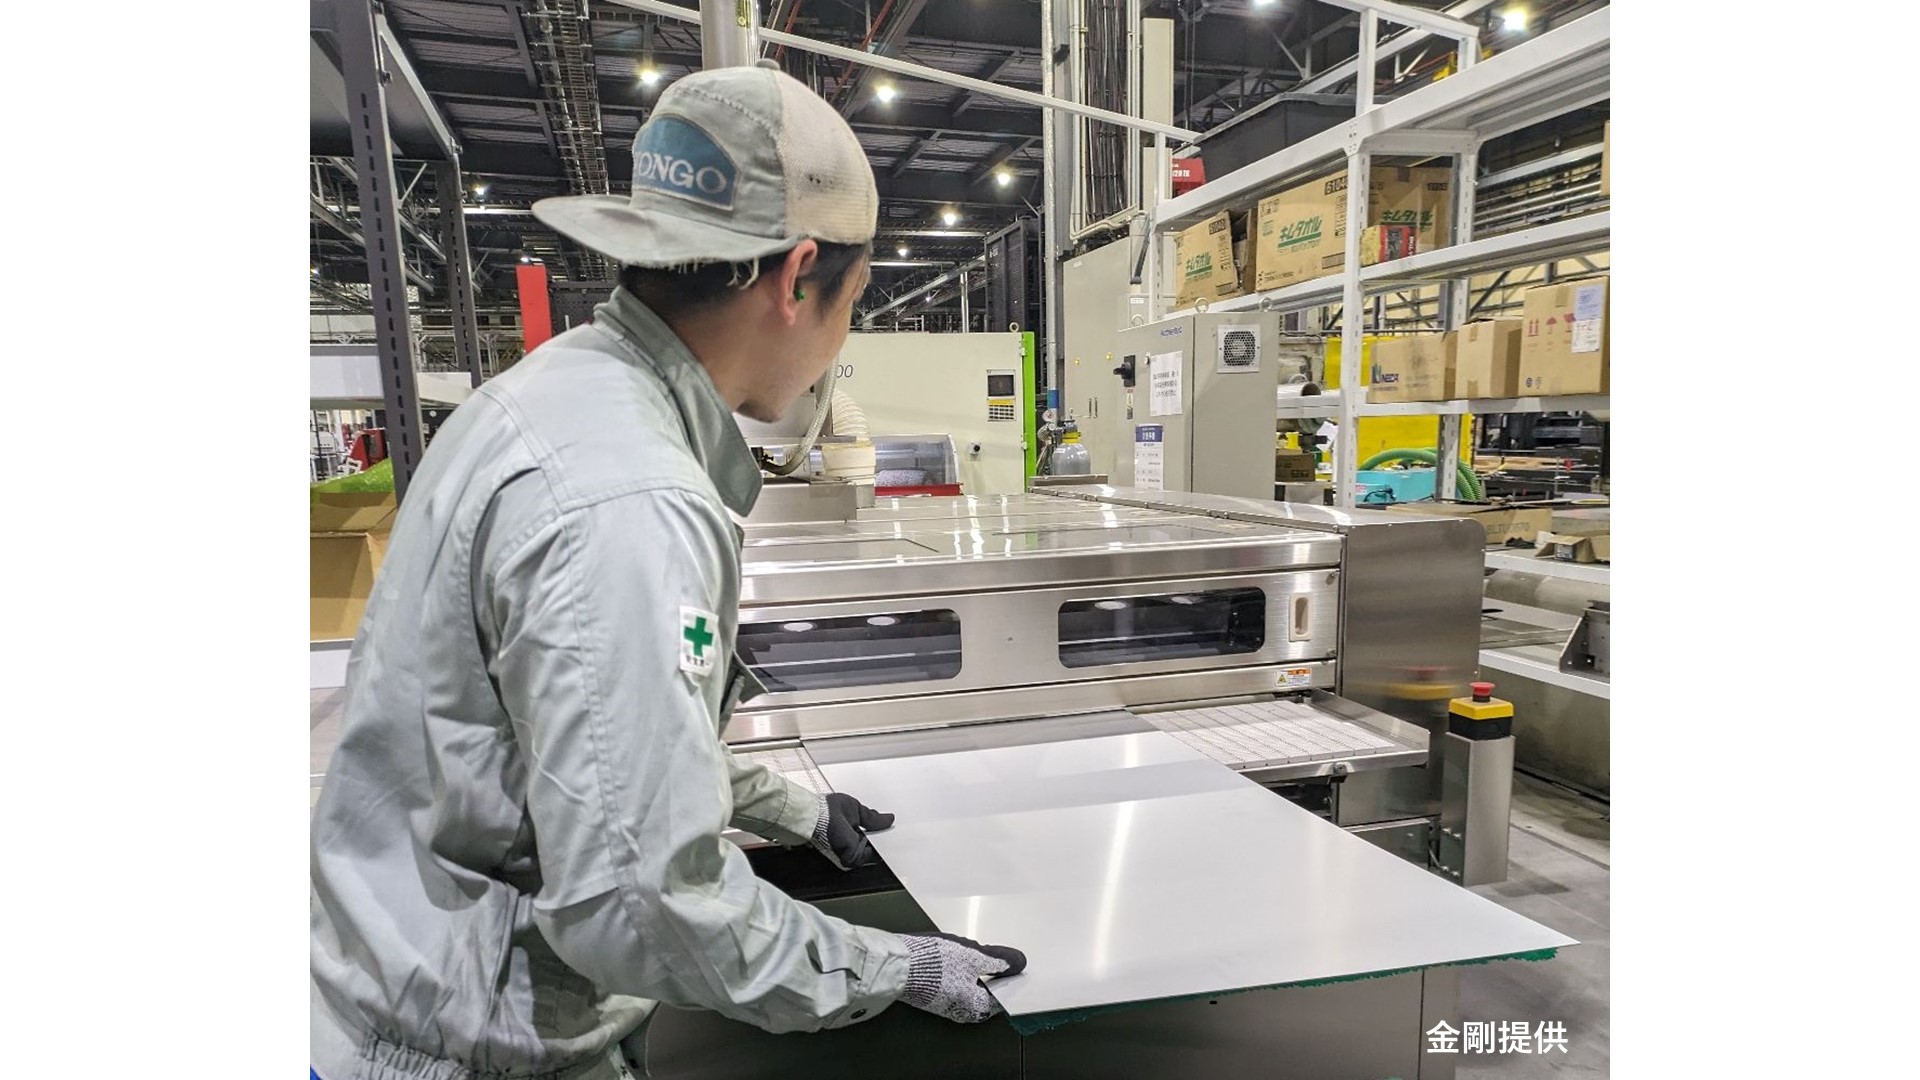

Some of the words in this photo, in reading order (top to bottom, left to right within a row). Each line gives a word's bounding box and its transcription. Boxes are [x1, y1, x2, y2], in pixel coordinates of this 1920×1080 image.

[1279, 216, 1322, 241] キムタオル
